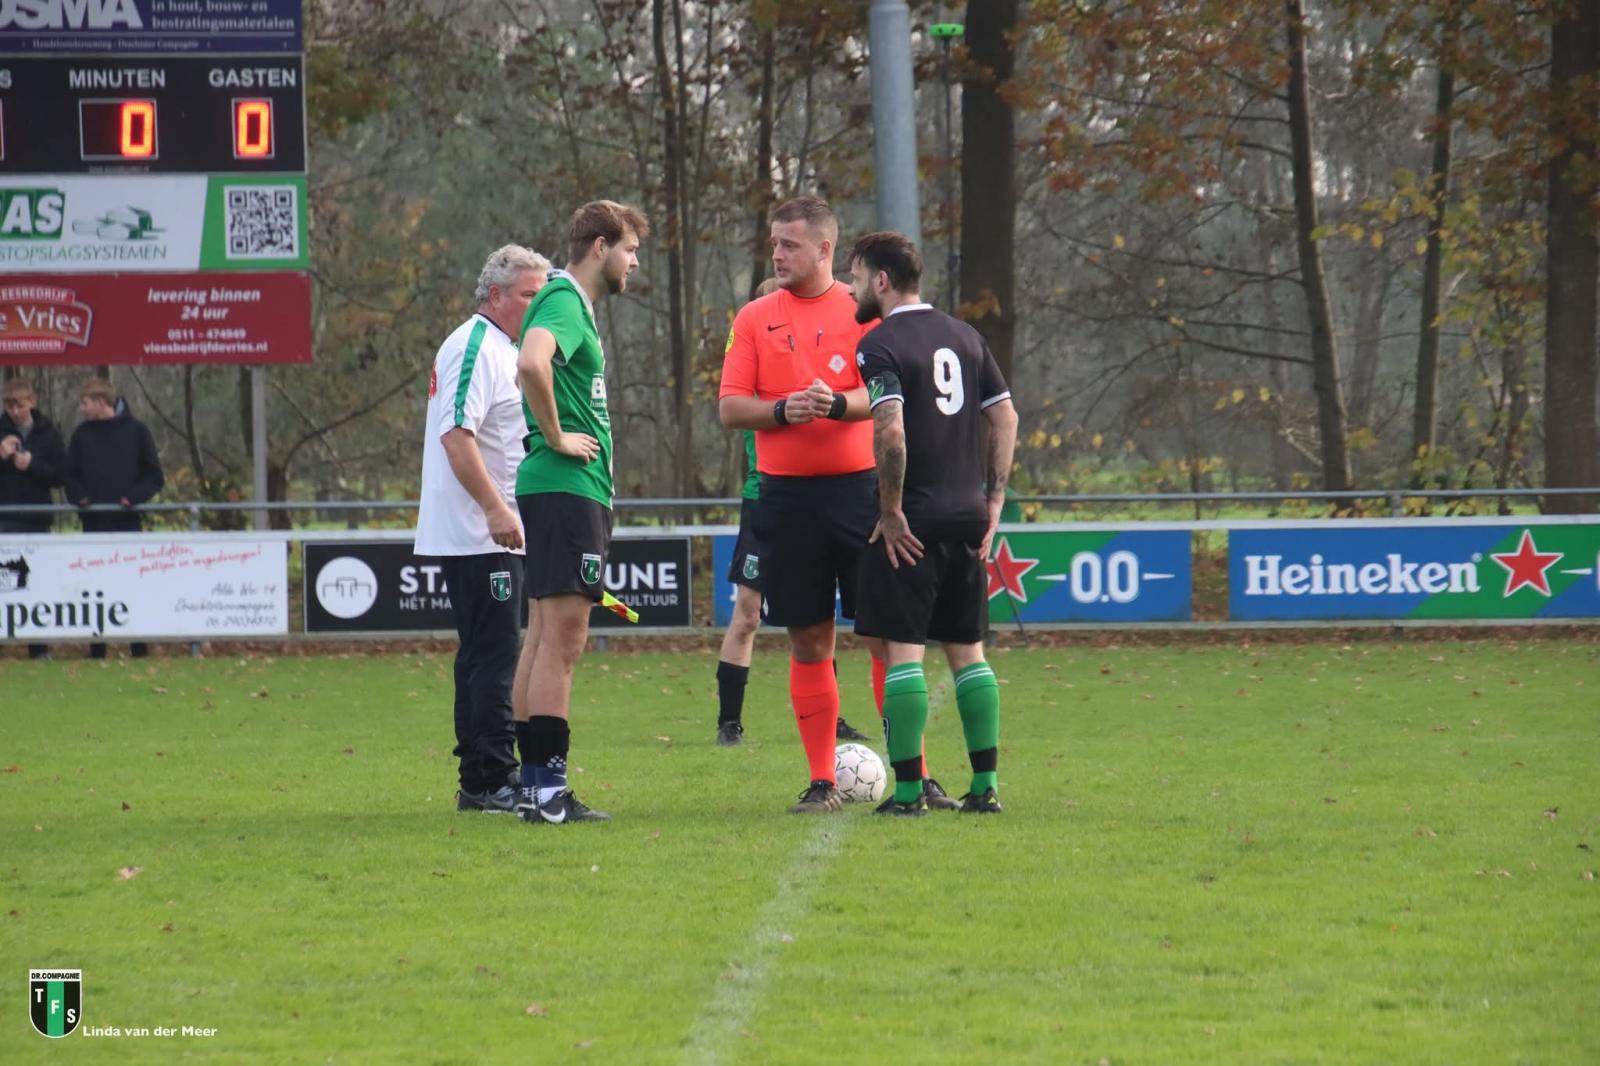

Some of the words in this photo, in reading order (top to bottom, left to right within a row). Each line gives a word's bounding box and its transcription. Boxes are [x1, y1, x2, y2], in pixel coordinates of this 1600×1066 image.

[252, 1, 268, 12] en
[69, 69, 166, 88] MINUTEN
[208, 69, 296, 88] GASTEN
[121, 101, 154, 157] 0
[237, 101, 270, 157] 0
[148, 288, 207, 305] levering
[211, 288, 261, 303] binnen
[16, 305, 81, 334] Vries
[181, 305, 199, 320] 24
[203, 307, 228, 319] uur
[933, 347, 964, 415] 9
[603, 562, 678, 591] UNE
[1071, 551, 1139, 603] 0.0
[1244, 553, 1481, 595] Heineken
